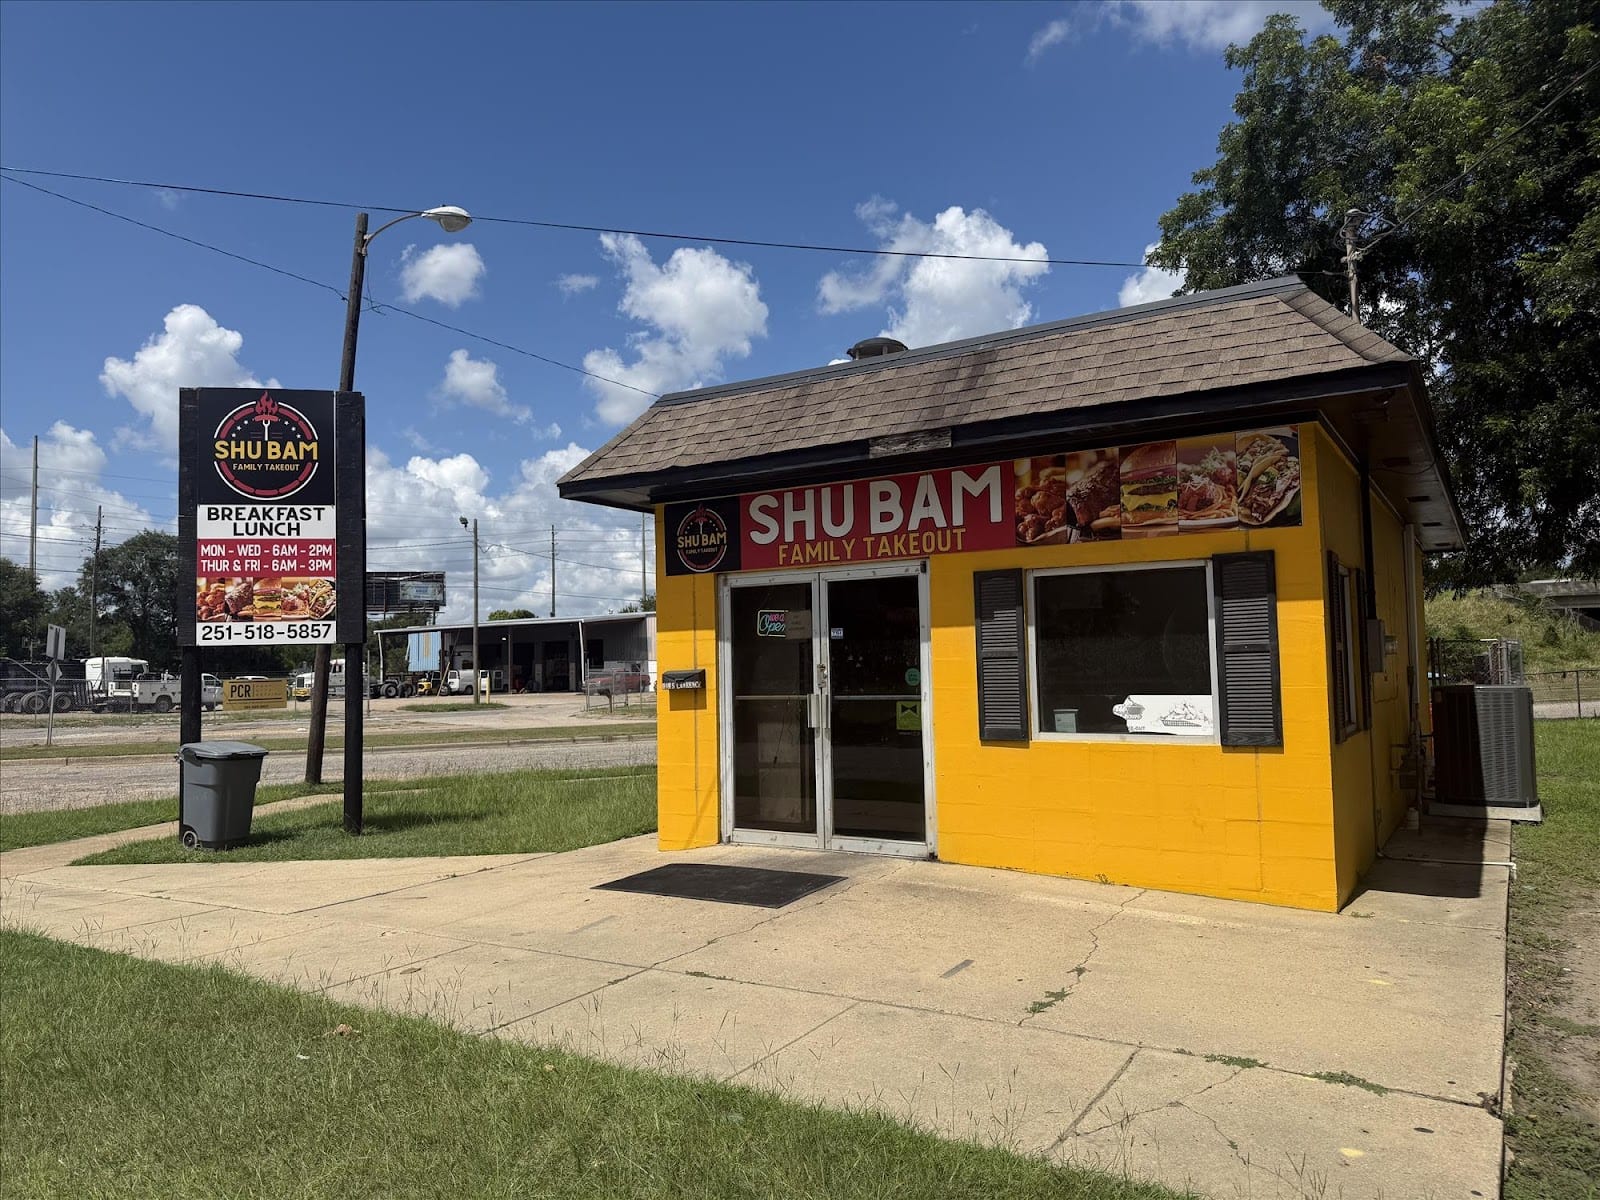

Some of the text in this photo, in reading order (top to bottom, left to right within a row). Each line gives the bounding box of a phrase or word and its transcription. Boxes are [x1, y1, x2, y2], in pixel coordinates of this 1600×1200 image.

[214, 440, 318, 460] SHU BAM
[232, 463, 300, 472] FAMILY TAKEOUT
[749, 466, 1003, 545] SHU BAM
[207, 507, 326, 521] BREAKFAST
[233, 522, 301, 537] LUNCH
[677, 532, 727, 549] SHU BAM
[778, 528, 966, 566] FAMILY TAKEOUT
[200, 544, 226, 557] MON
[236, 544, 261, 557] WED
[272, 544, 298, 557] 6AM
[308, 544, 333, 557] 2PM
[200, 560, 230, 572] THUR
[232, 560, 242, 572] &
[244, 560, 261, 572] FRI
[271, 560, 297, 572] 6AM
[308, 559, 332, 572] 3PM
[201, 623, 332, 641] 251-518-5857
[230, 684, 251, 698] PCR
